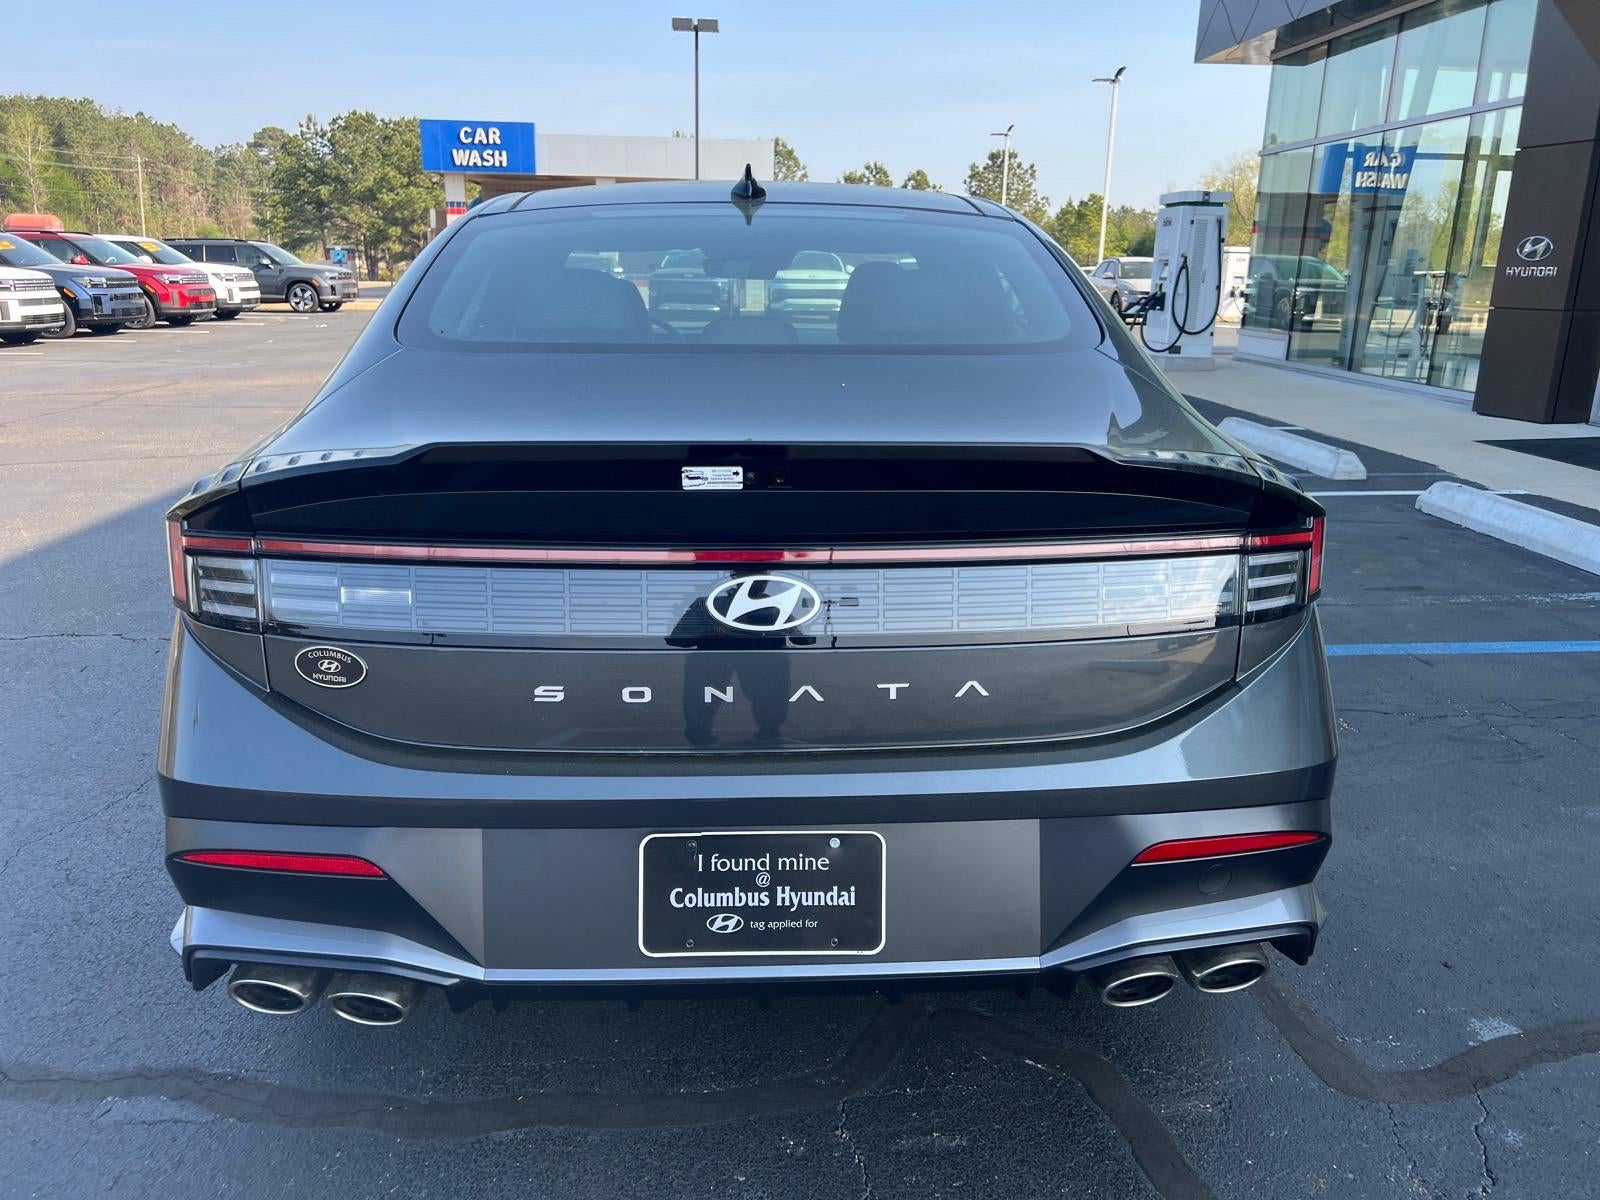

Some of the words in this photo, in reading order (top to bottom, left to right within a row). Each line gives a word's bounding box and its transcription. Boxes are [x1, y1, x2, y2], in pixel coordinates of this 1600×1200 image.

[459, 126, 502, 145] CAR
[451, 148, 508, 168] WASH
[1505, 266, 1558, 277] HYUNDAI
[307, 650, 352, 664] COLUMBUS
[312, 672, 347, 683] HYUNDAI
[533, 680, 990, 703] SONATA
[697, 854, 703, 872] I
[710, 853, 770, 872] found
[777, 853, 830, 871] mine
[755, 872, 771, 888] @
[669, 887, 770, 909] Columbus
[776, 885, 857, 912] Hyundai
[750, 919, 766, 931] tag
[767, 918, 803, 931] applied
[805, 918, 819, 928] for
